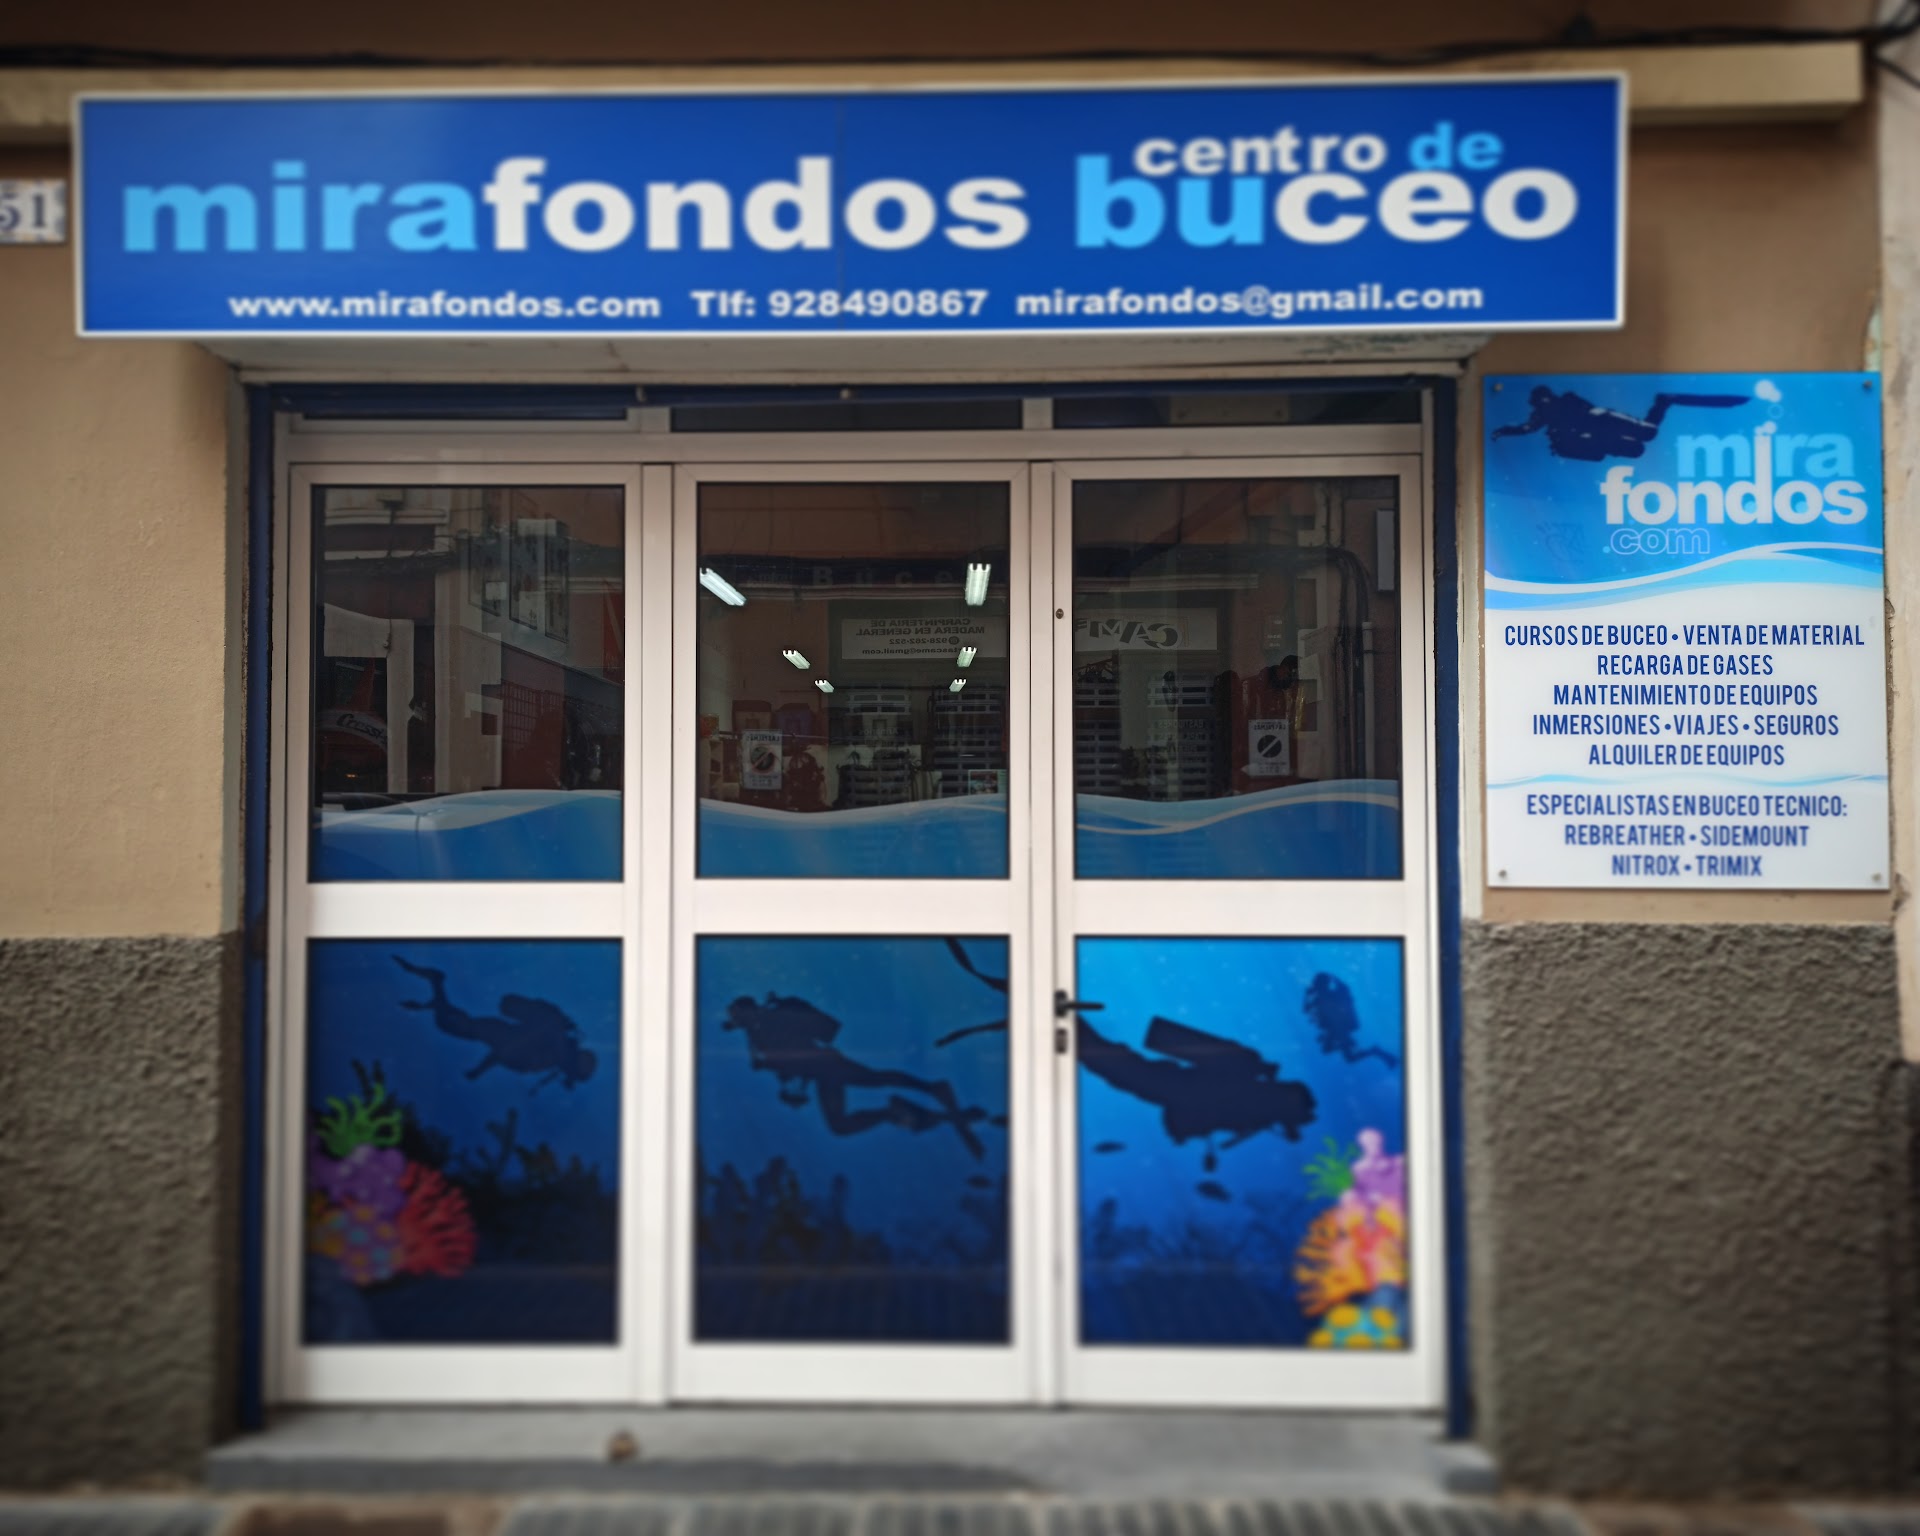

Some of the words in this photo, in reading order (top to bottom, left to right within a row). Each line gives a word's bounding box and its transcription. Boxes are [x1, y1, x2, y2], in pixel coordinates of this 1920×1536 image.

[1134, 126, 1387, 175] centro
[1409, 121, 1504, 171] de
[123, 155, 1030, 253] mirafondos
[1075, 153, 1580, 249] buceo
[228, 289, 661, 319] www.mirafondos.com
[690, 288, 756, 317] Tlf:
[768, 288, 988, 317] 928490867
[1015, 282, 1485, 319] mirafondos@gmail.com
[1677, 421, 1855, 479] mira
[1600, 464, 1868, 525] fondos
[1504, 625, 1579, 646] CURSOS
[1581, 625, 1604, 646] DE
[1607, 625, 1668, 646] BUCEO
[1682, 625, 1743, 646] VENTA
[1746, 625, 1769, 646] DE
[1771, 625, 1865, 646] MATERIAL
[1597, 655, 1684, 676] RECARGA
[1687, 655, 1710, 676] DE
[1713, 655, 1774, 676] GASES
[1553, 684, 1711, 706] MANTENIMIENTO
[1714, 684, 1737, 706] DE
[1740, 684, 1818, 706] EQUIPOS
[1533, 714, 1661, 736] INMERSIONES
[1673, 714, 1739, 736] VIAJES
[1754, 714, 1839, 736] SEGUROS
[1588, 744, 1677, 766] ALQUILER
[1680, 744, 1704, 766] DE
[1706, 744, 1785, 767] EQUIPOS
[1527, 794, 1670, 816] ESPECIALISTAS
[1672, 794, 1696, 816] EN
[1699, 794, 1760, 816] BUCEO
[1763, 794, 1848, 817] TECNICO:
[1565, 824, 1685, 847] REBREATHER
[1700, 824, 1809, 847] SIDEMOUNT
[1612, 854, 1680, 876] NITROX
[1695, 854, 1762, 877] TRIMIX
